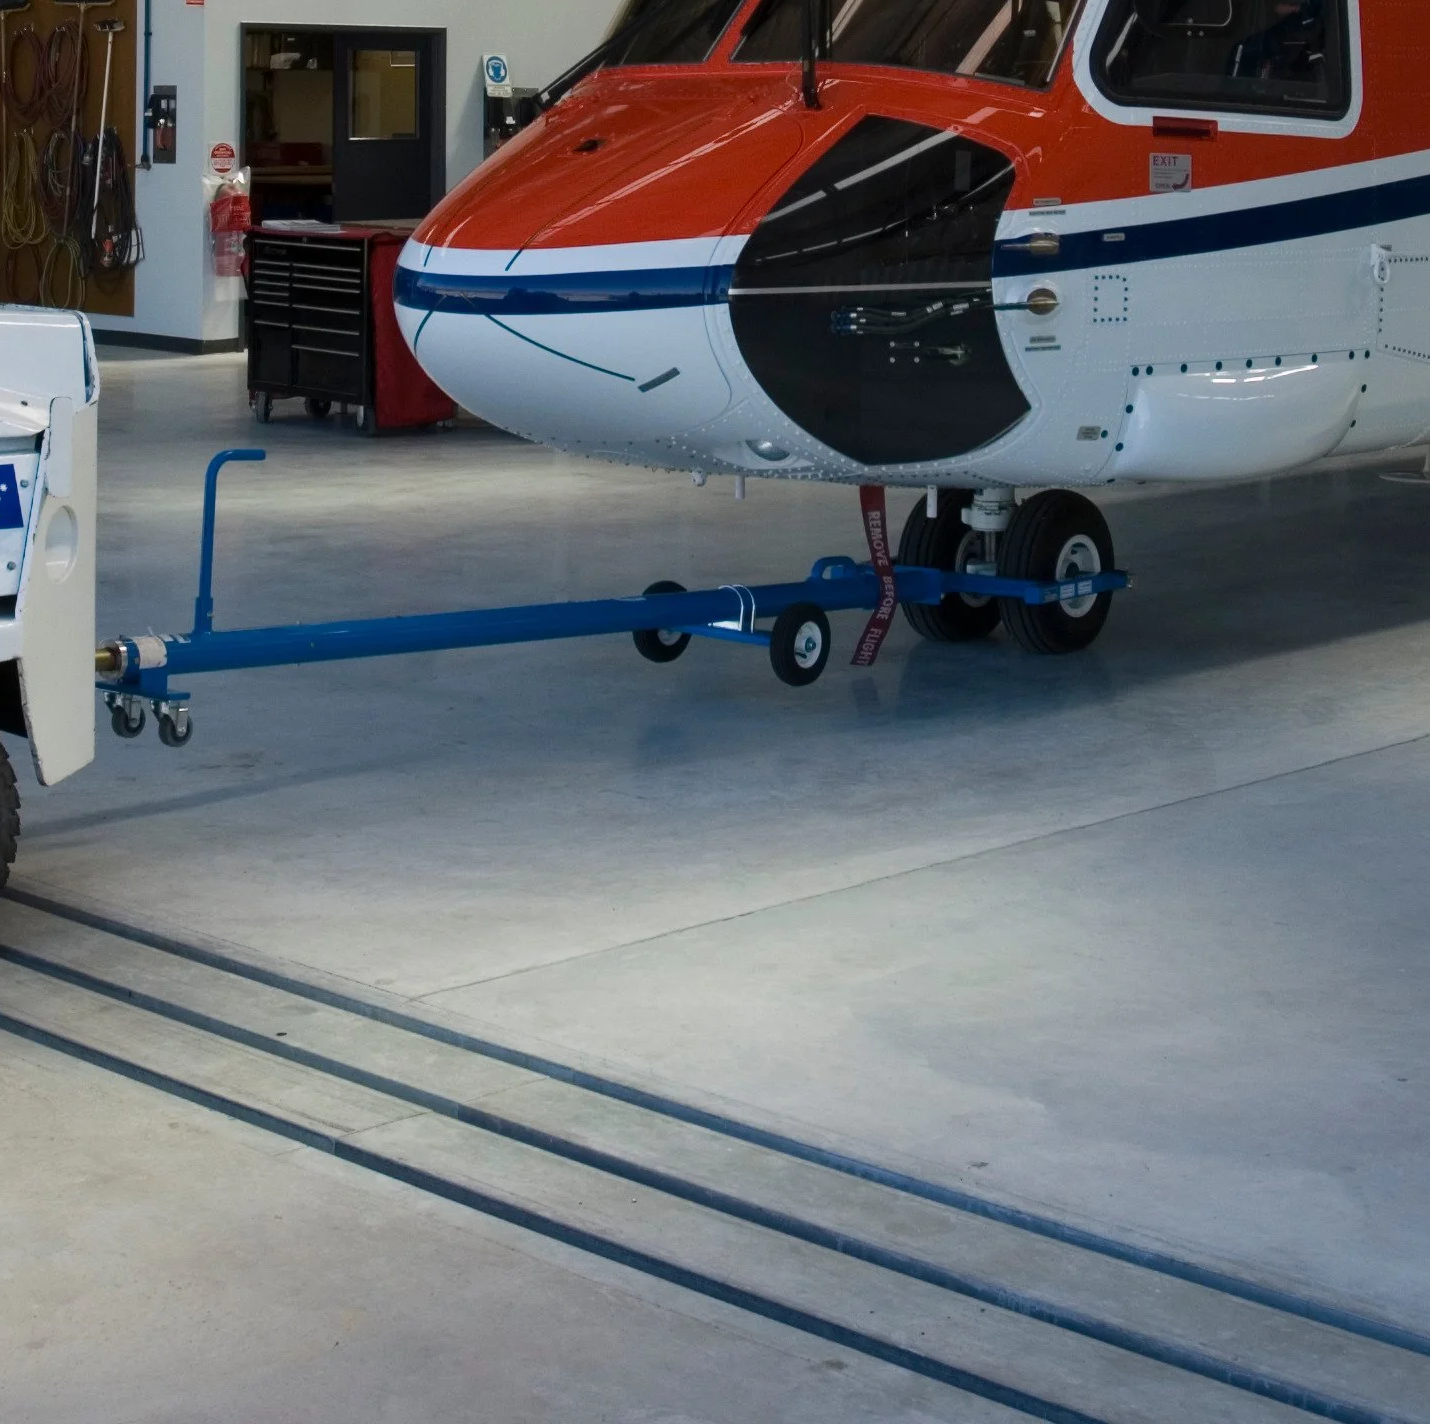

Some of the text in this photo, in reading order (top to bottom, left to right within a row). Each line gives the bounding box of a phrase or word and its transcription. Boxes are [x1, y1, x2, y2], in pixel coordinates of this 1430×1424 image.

[1153, 156, 1178, 166] EXIT
[856, 511, 894, 666] REMOVE BEFORE FLIGHT
